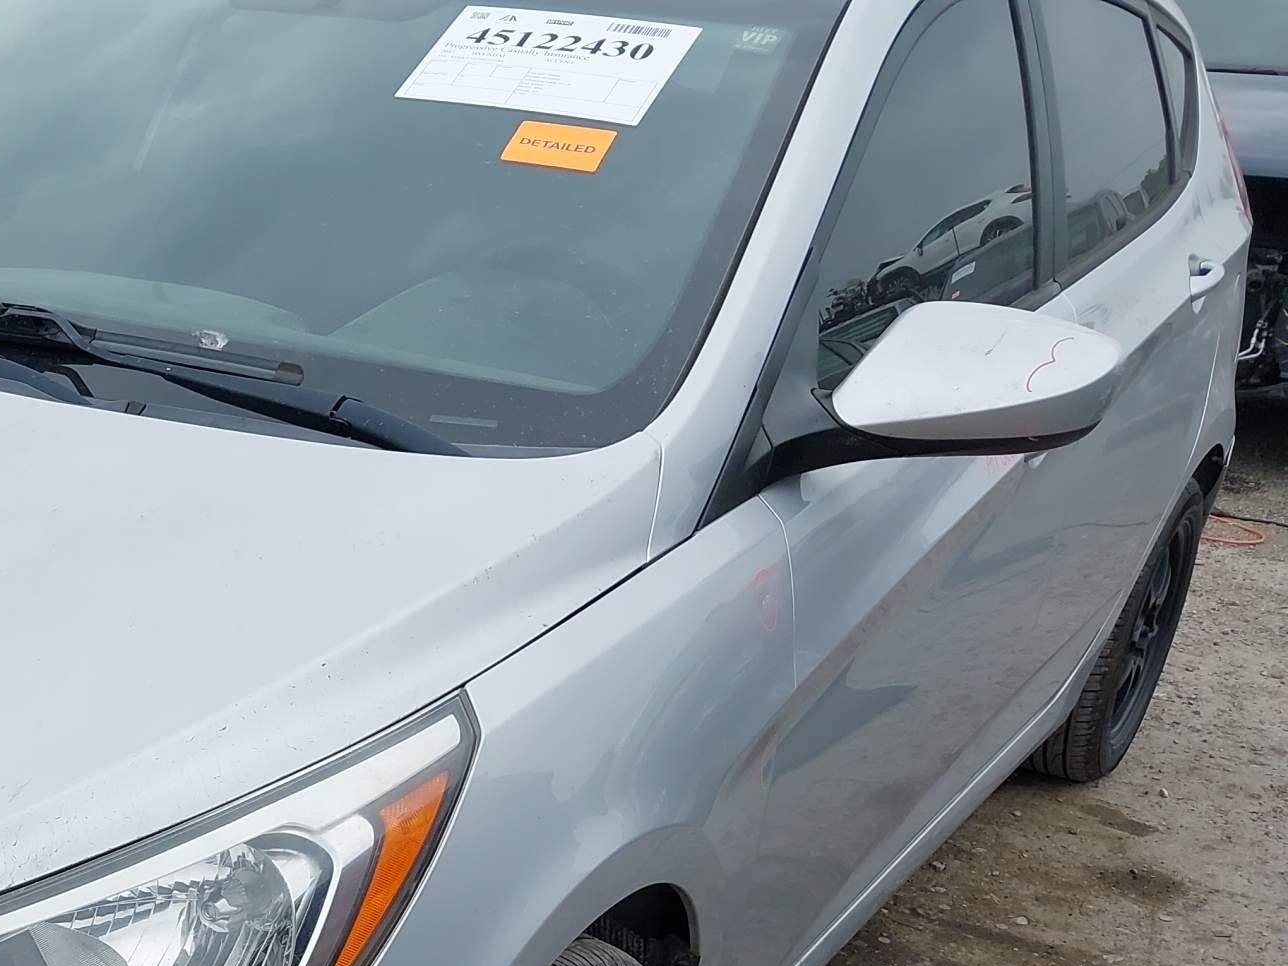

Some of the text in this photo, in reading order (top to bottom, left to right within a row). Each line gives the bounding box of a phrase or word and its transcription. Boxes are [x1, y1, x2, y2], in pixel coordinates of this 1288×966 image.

[465, 27, 655, 61] 45122430
[742, 30, 778, 45] VIP
[519, 137, 597, 154] DETAILED
